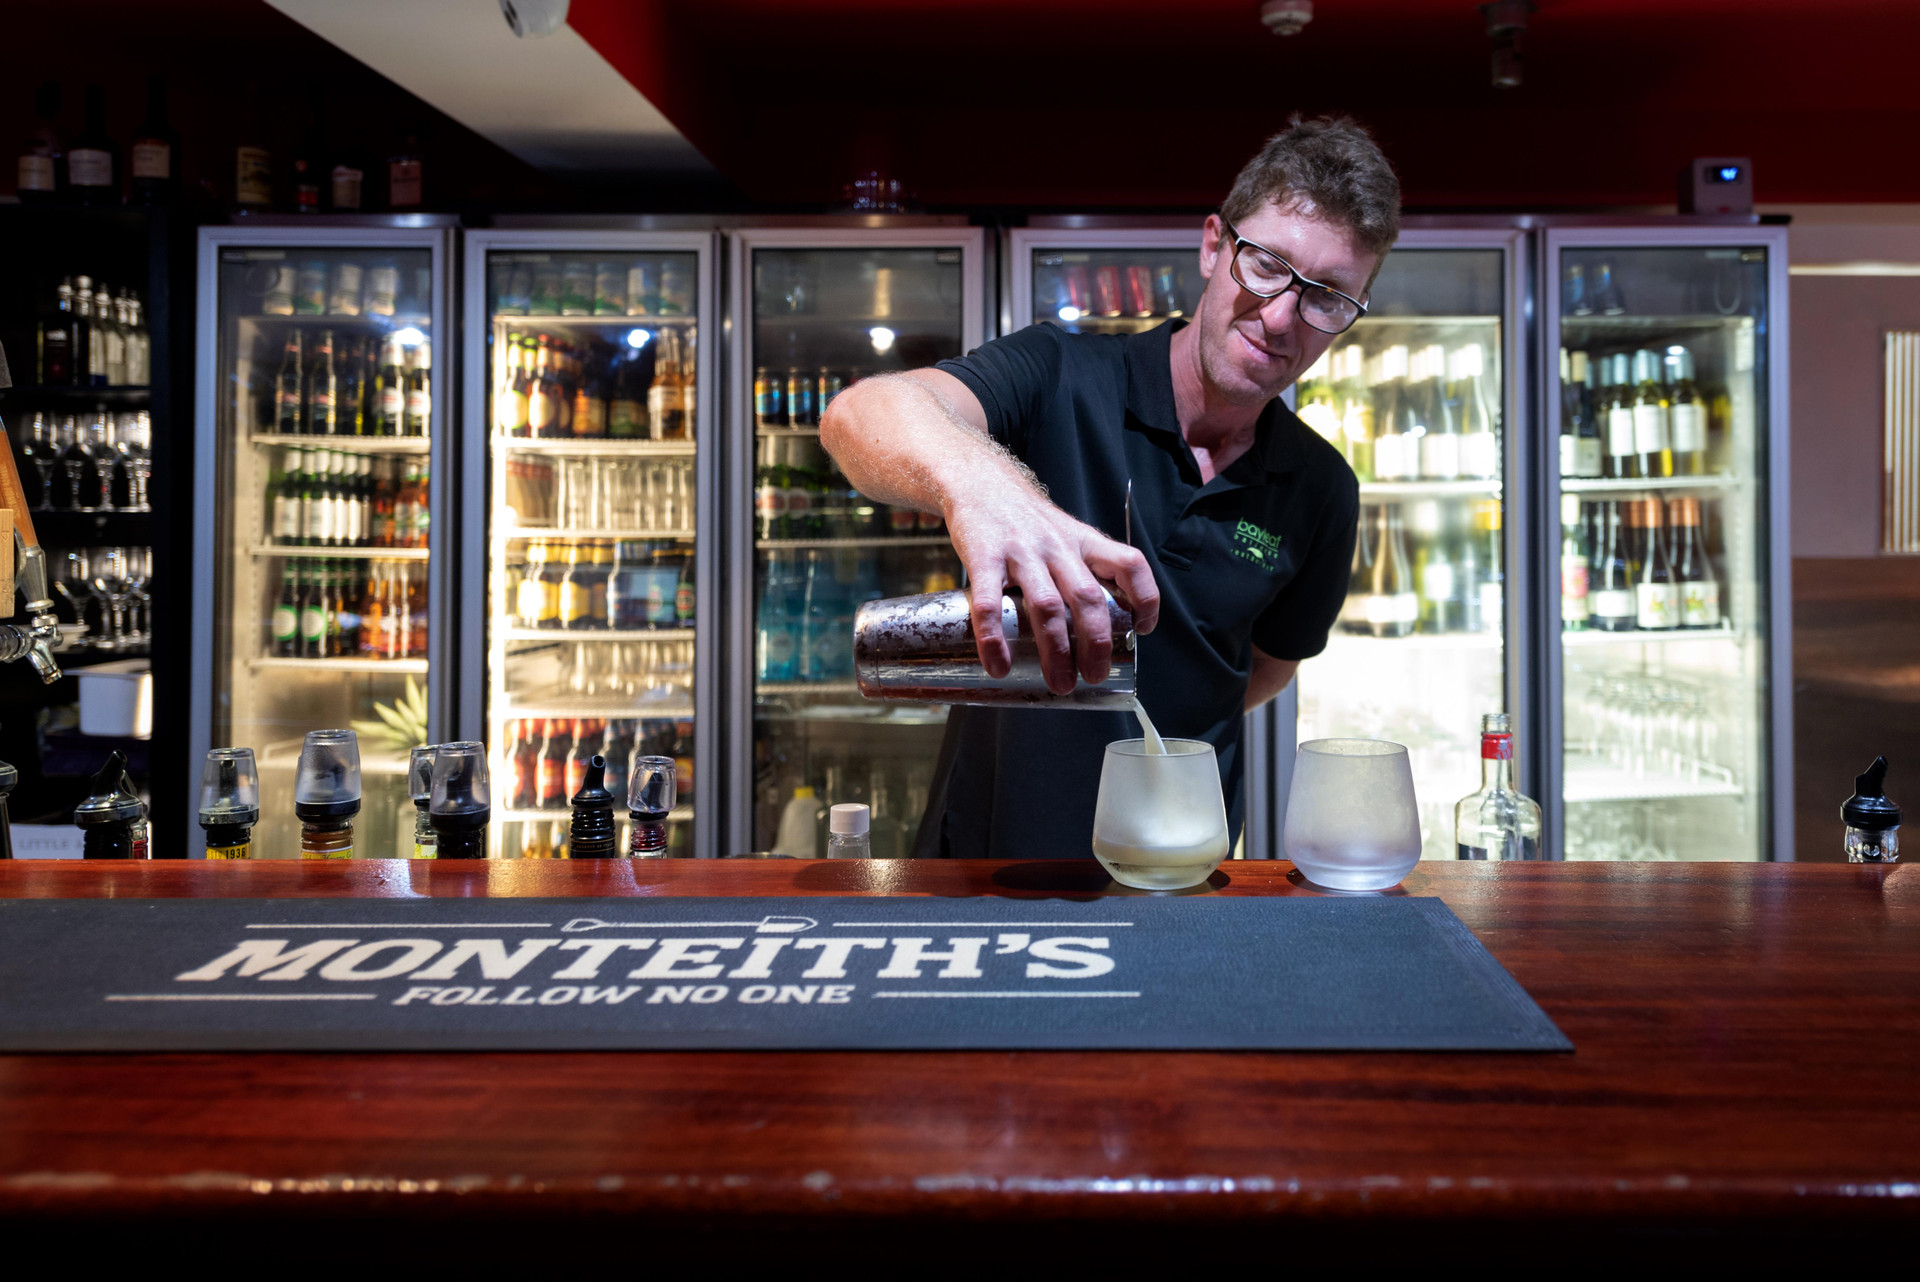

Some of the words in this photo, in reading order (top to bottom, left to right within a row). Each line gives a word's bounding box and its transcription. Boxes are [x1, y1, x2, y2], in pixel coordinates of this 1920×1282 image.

[1237, 517, 1281, 548] bayleaf
[19, 838, 69, 850] LITTLE
[226, 847, 246, 859] 1936
[174, 934, 1115, 981] MONTEITH'S
[391, 985, 642, 1006] FOLLOW
[646, 985, 729, 1004] NO
[737, 985, 856, 1004] ONE
